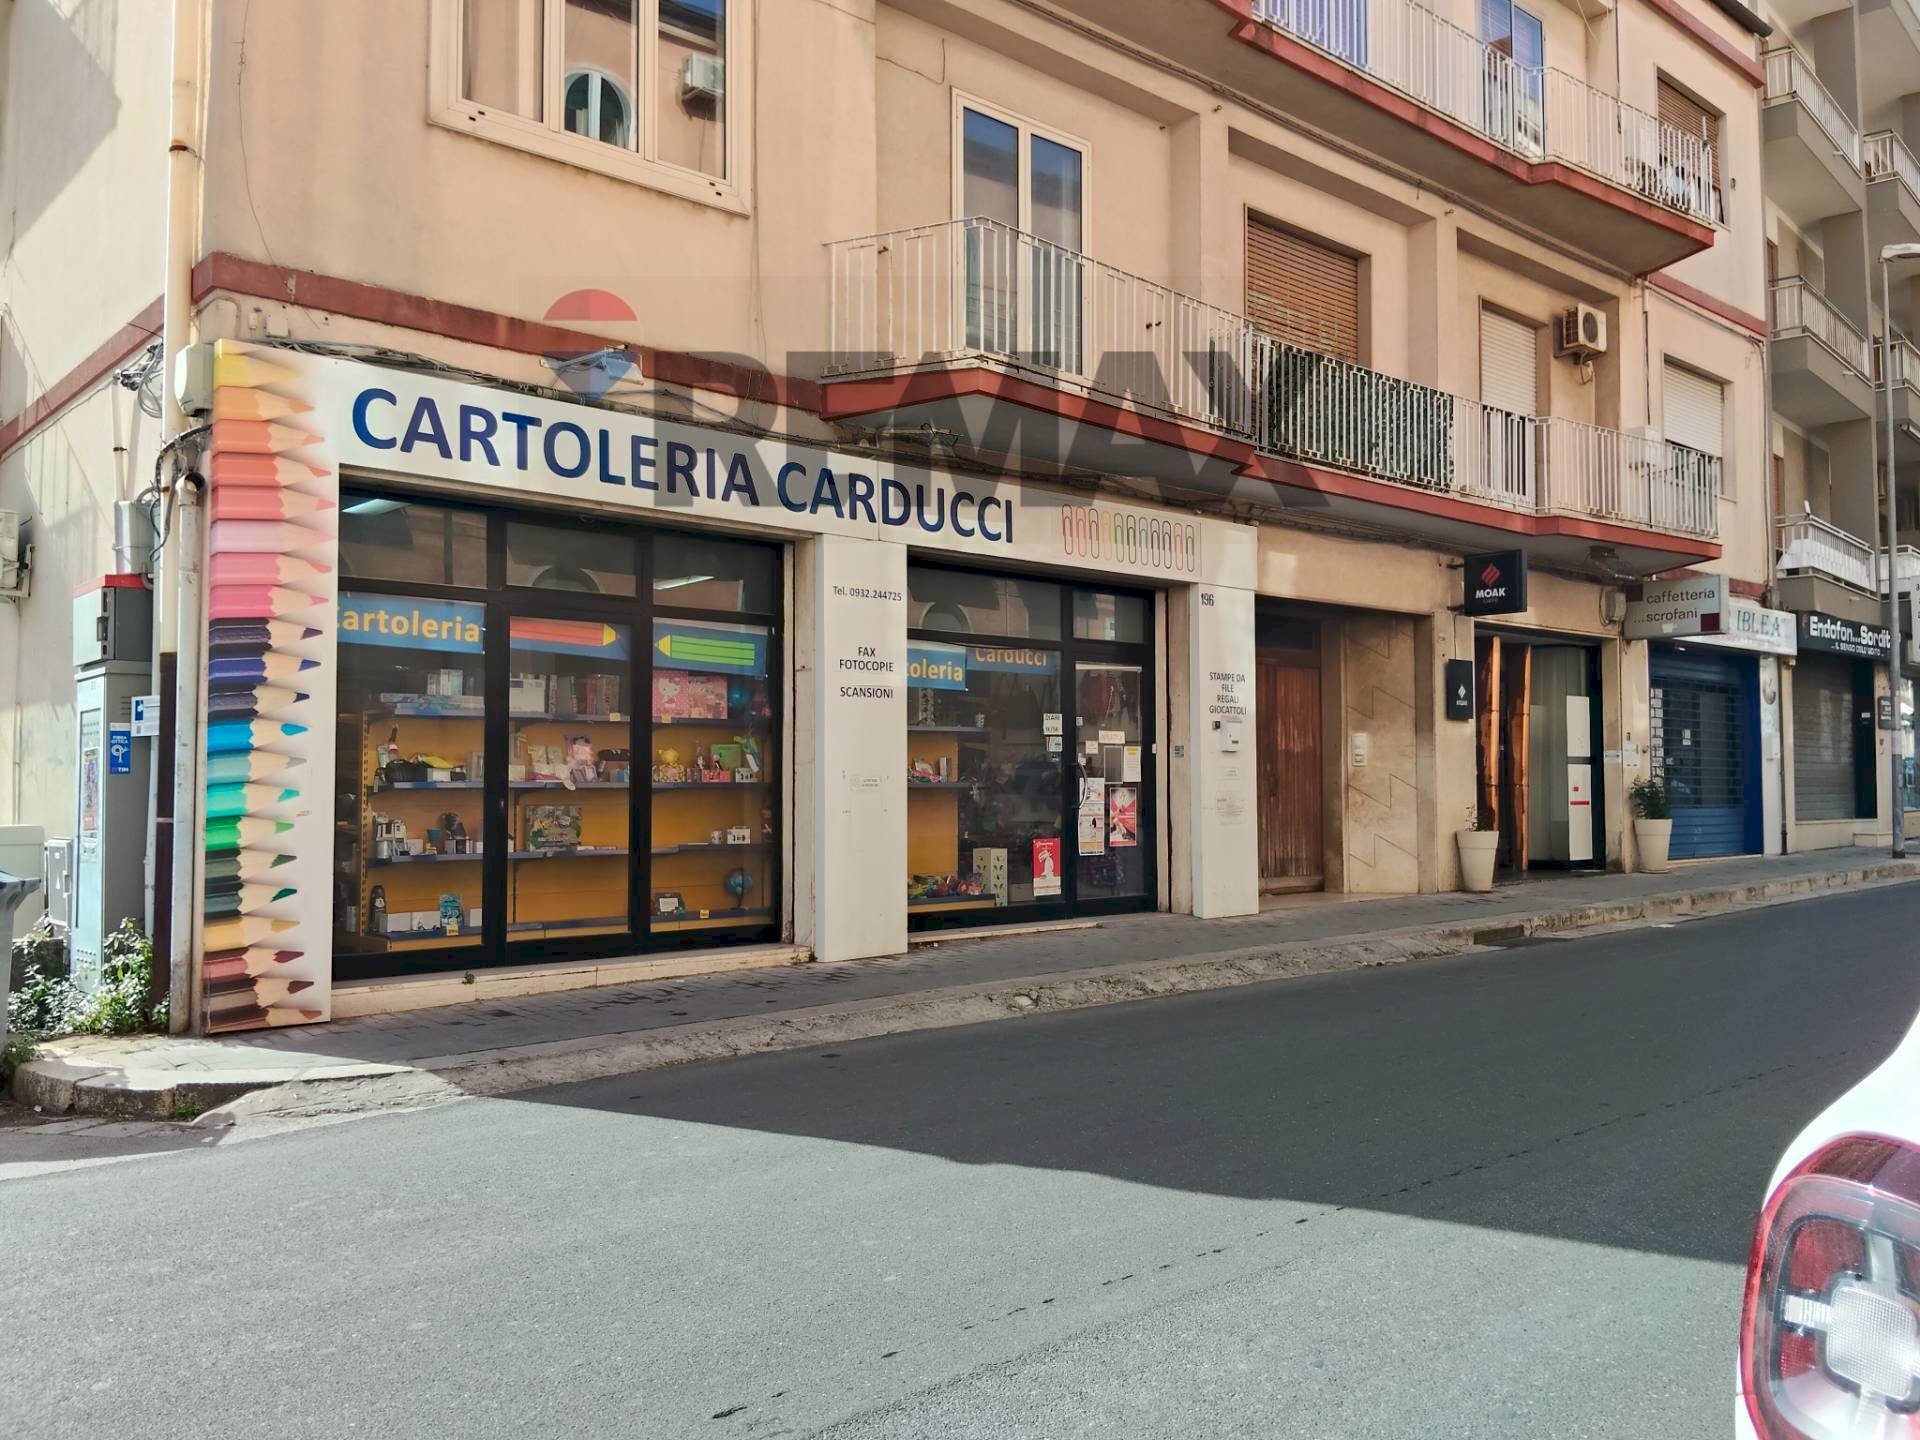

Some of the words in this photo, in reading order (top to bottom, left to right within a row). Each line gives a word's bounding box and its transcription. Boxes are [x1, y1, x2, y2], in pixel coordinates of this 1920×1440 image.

[352, 387, 760, 506] CARTOLERIA
[776, 461, 1013, 544] CARDUCCI
[833, 585, 848, 596] Tel.
[849, 587, 902, 602] 0932.244725
[1200, 592, 1215, 606] 196
[1475, 587, 1506, 599] MOAK
[1646, 588, 1715, 604] caffetteria
[337, 608, 479, 642] artoleria
[1737, 609, 1781, 637] IBLEA
[858, 646, 876, 658] FAX
[839, 659, 894, 672] FOTOCOPIE
[906, 658, 963, 681] oleria
[1209, 671, 1235, 682] STAMPE
[1236, 673, 1246, 682] DA
[840, 686, 894, 699] SCANSIONI
[1221, 683, 1234, 693] FILE
[1216, 694, 1239, 704] REGALI
[1209, 705, 1246, 715] GIOCATTOLI
